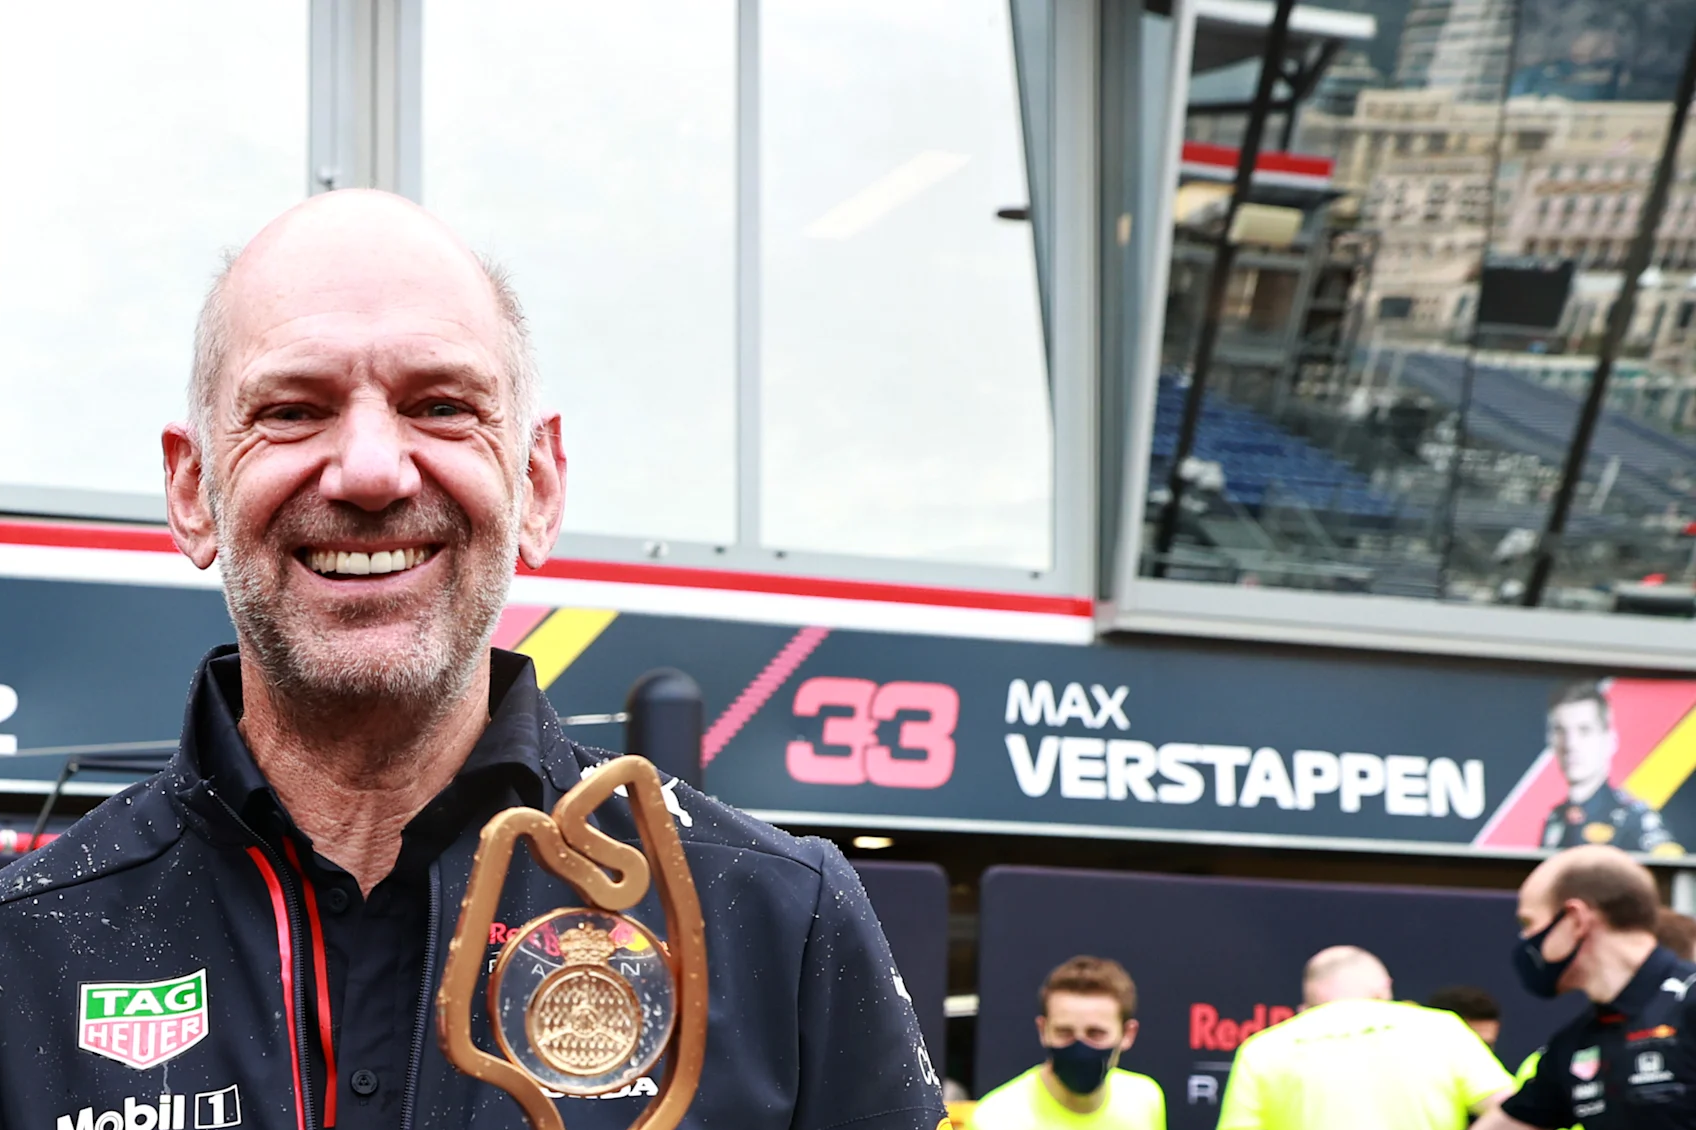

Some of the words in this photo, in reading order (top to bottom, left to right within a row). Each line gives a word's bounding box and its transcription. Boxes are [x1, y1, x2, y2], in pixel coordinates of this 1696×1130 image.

[1005, 678, 1131, 731] MAX
[786, 676, 960, 789] 33
[1004, 733, 1486, 820] VERSTAPPEN
[92, 982, 196, 1016] TAG
[88, 1017, 200, 1064] HEUER
